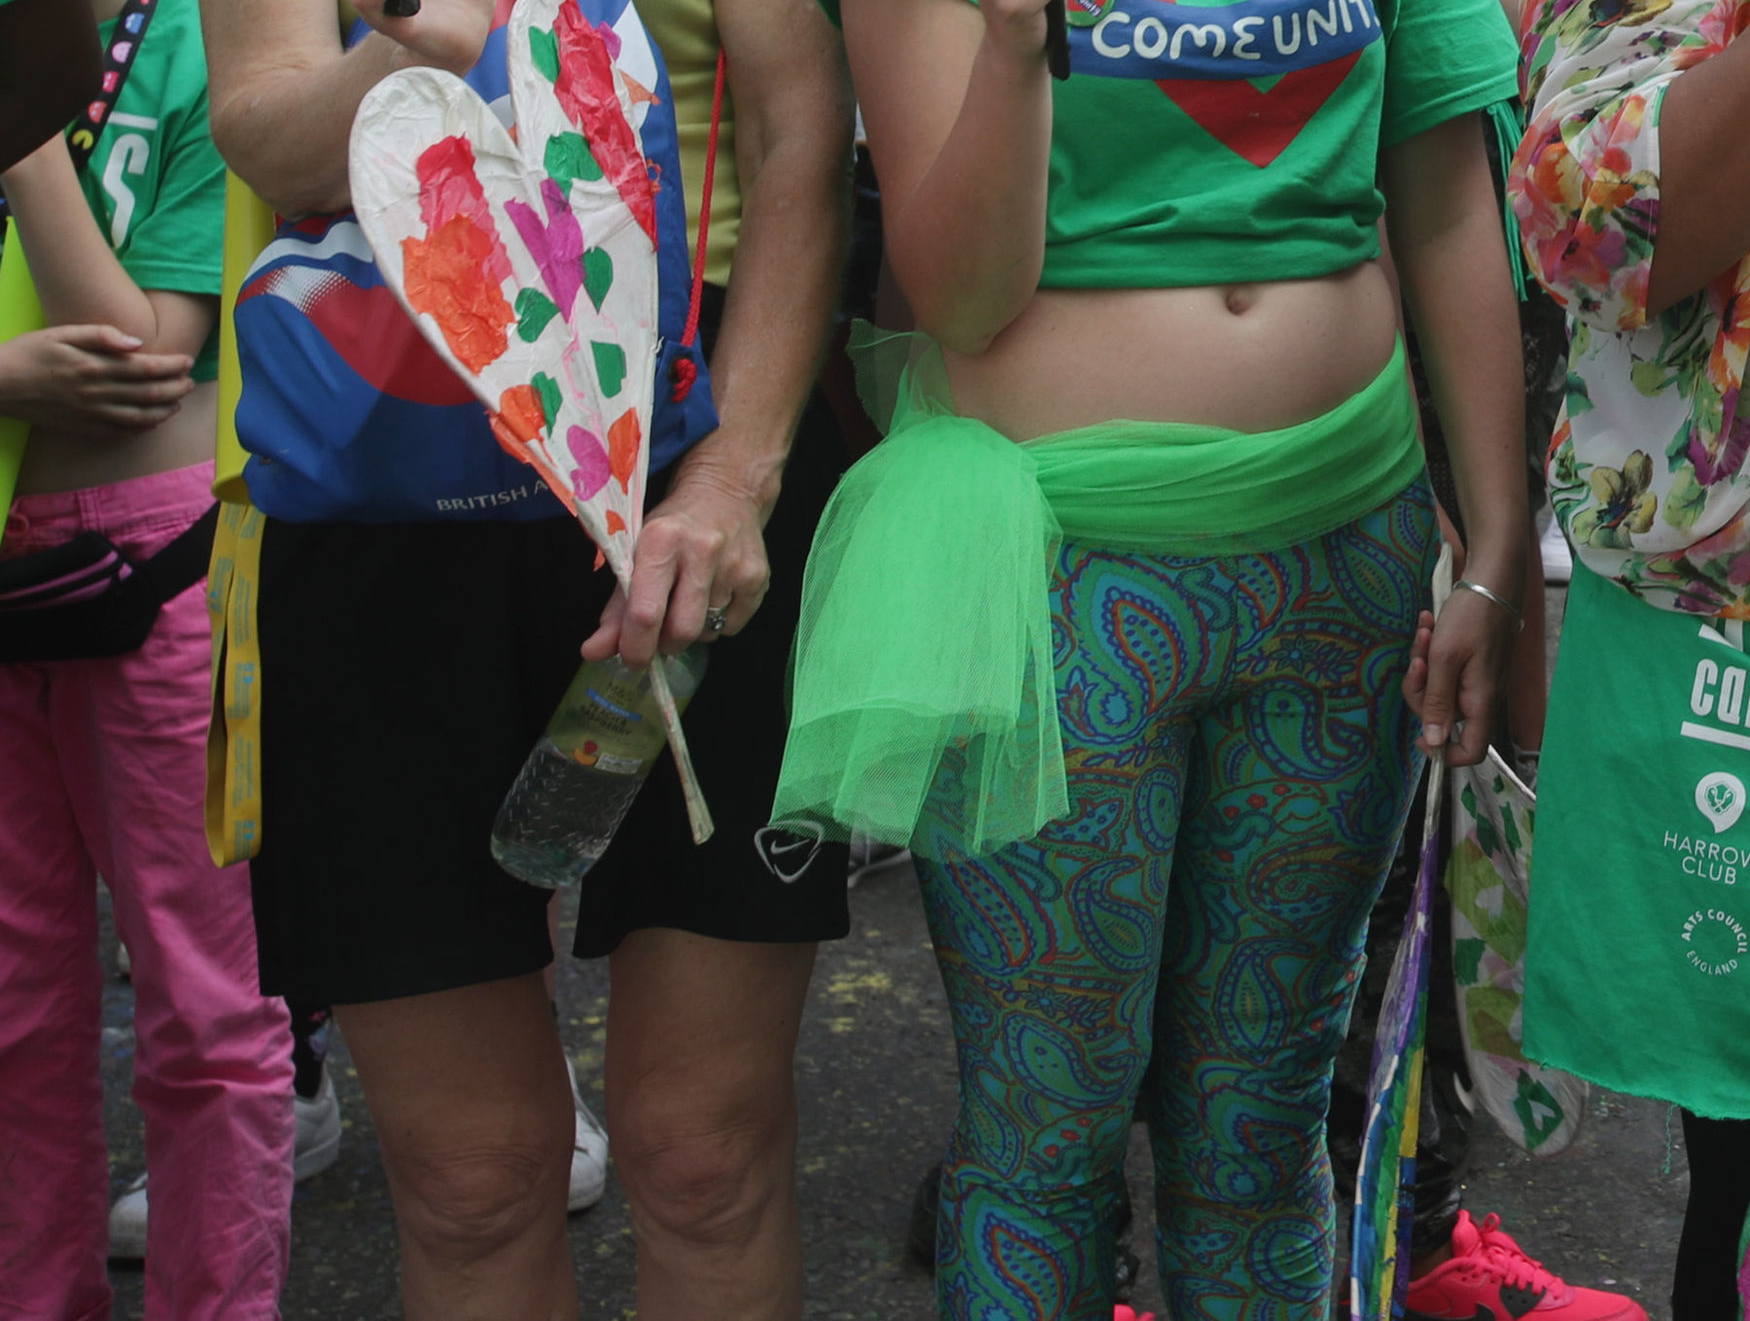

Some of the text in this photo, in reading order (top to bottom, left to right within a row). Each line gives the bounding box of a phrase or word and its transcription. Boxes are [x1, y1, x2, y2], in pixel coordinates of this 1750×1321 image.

[436, 486, 528, 511] BRITISH
[1682, 855, 1738, 885] CLUB
[1681, 909, 1748, 953] ARTS COUNCIL
[1686, 950, 1738, 976] ENGLAND
